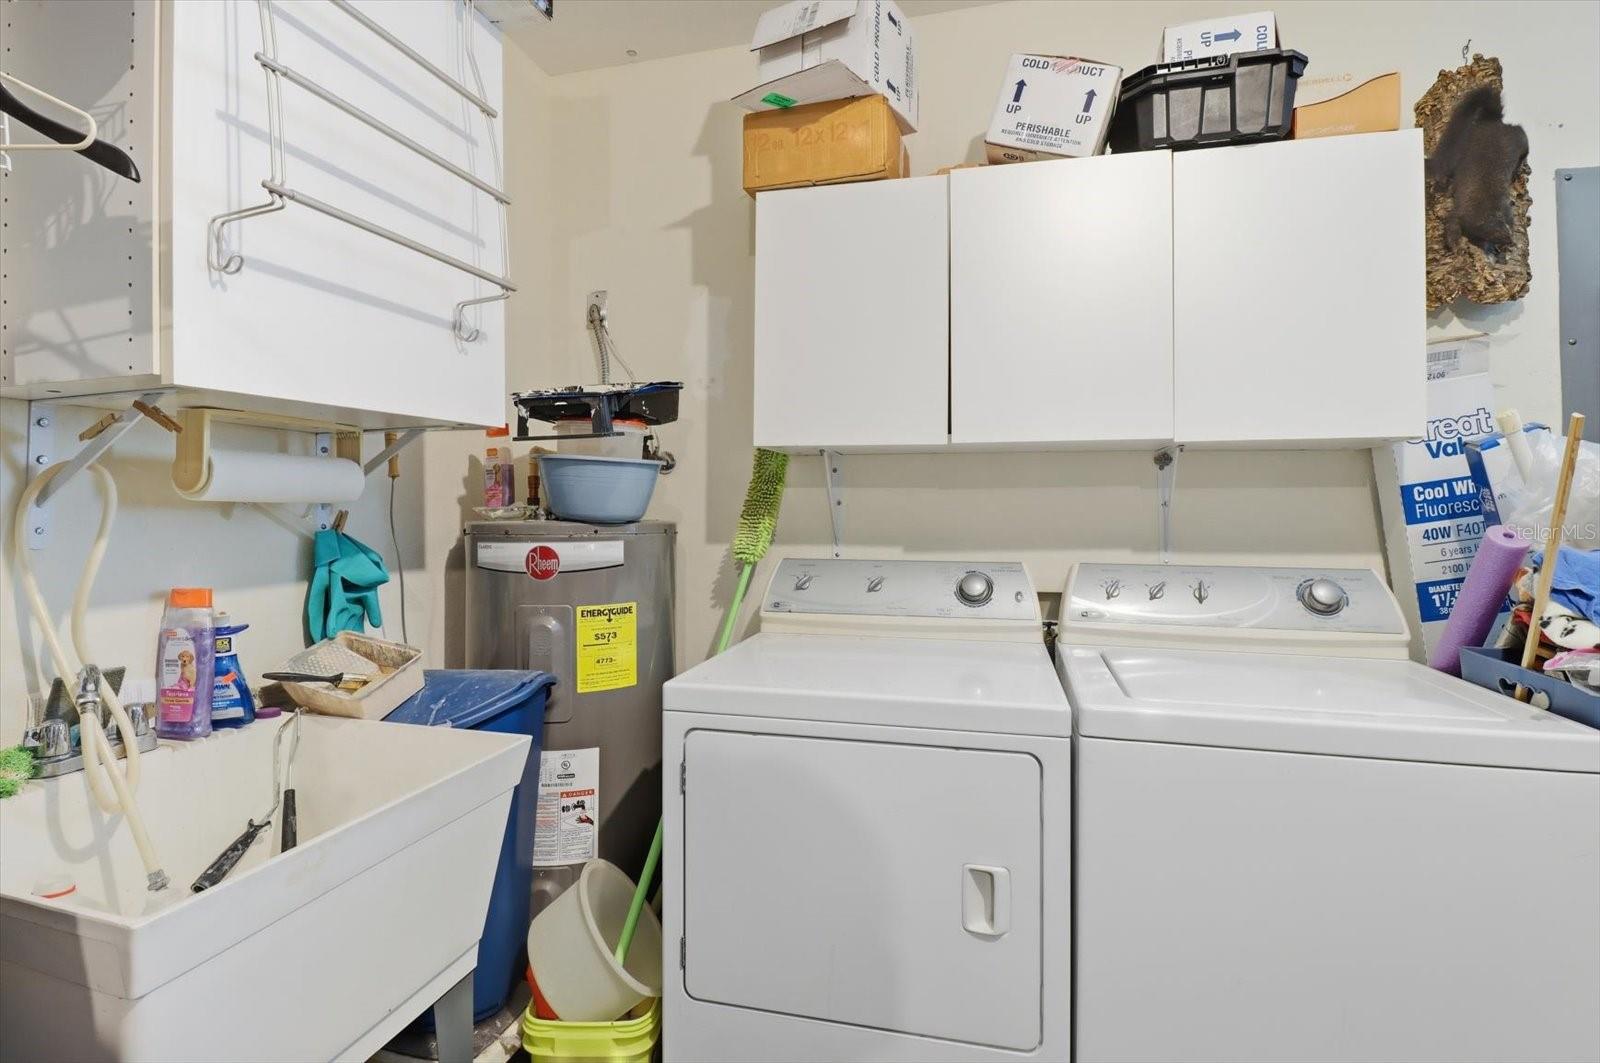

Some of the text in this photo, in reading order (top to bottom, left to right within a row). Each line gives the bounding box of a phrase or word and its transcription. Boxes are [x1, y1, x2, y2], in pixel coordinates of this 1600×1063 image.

[1200, 31, 1212, 48] UP
[1022, 58, 1050, 70] COLD
[1005, 103, 1022, 114] UP
[1075, 114, 1092, 125] UP
[1015, 121, 1072, 138] PERISHABLE
[1413, 482, 1450, 501] Cool
[1422, 526, 1451, 541] 40W
[1440, 548, 1447, 557] 6
[1448, 545, 1472, 557] years
[528, 546, 559, 575] Rheem
[1441, 563, 1464, 575] 2100
[581, 606, 633, 618] ENERGYGUIDE
